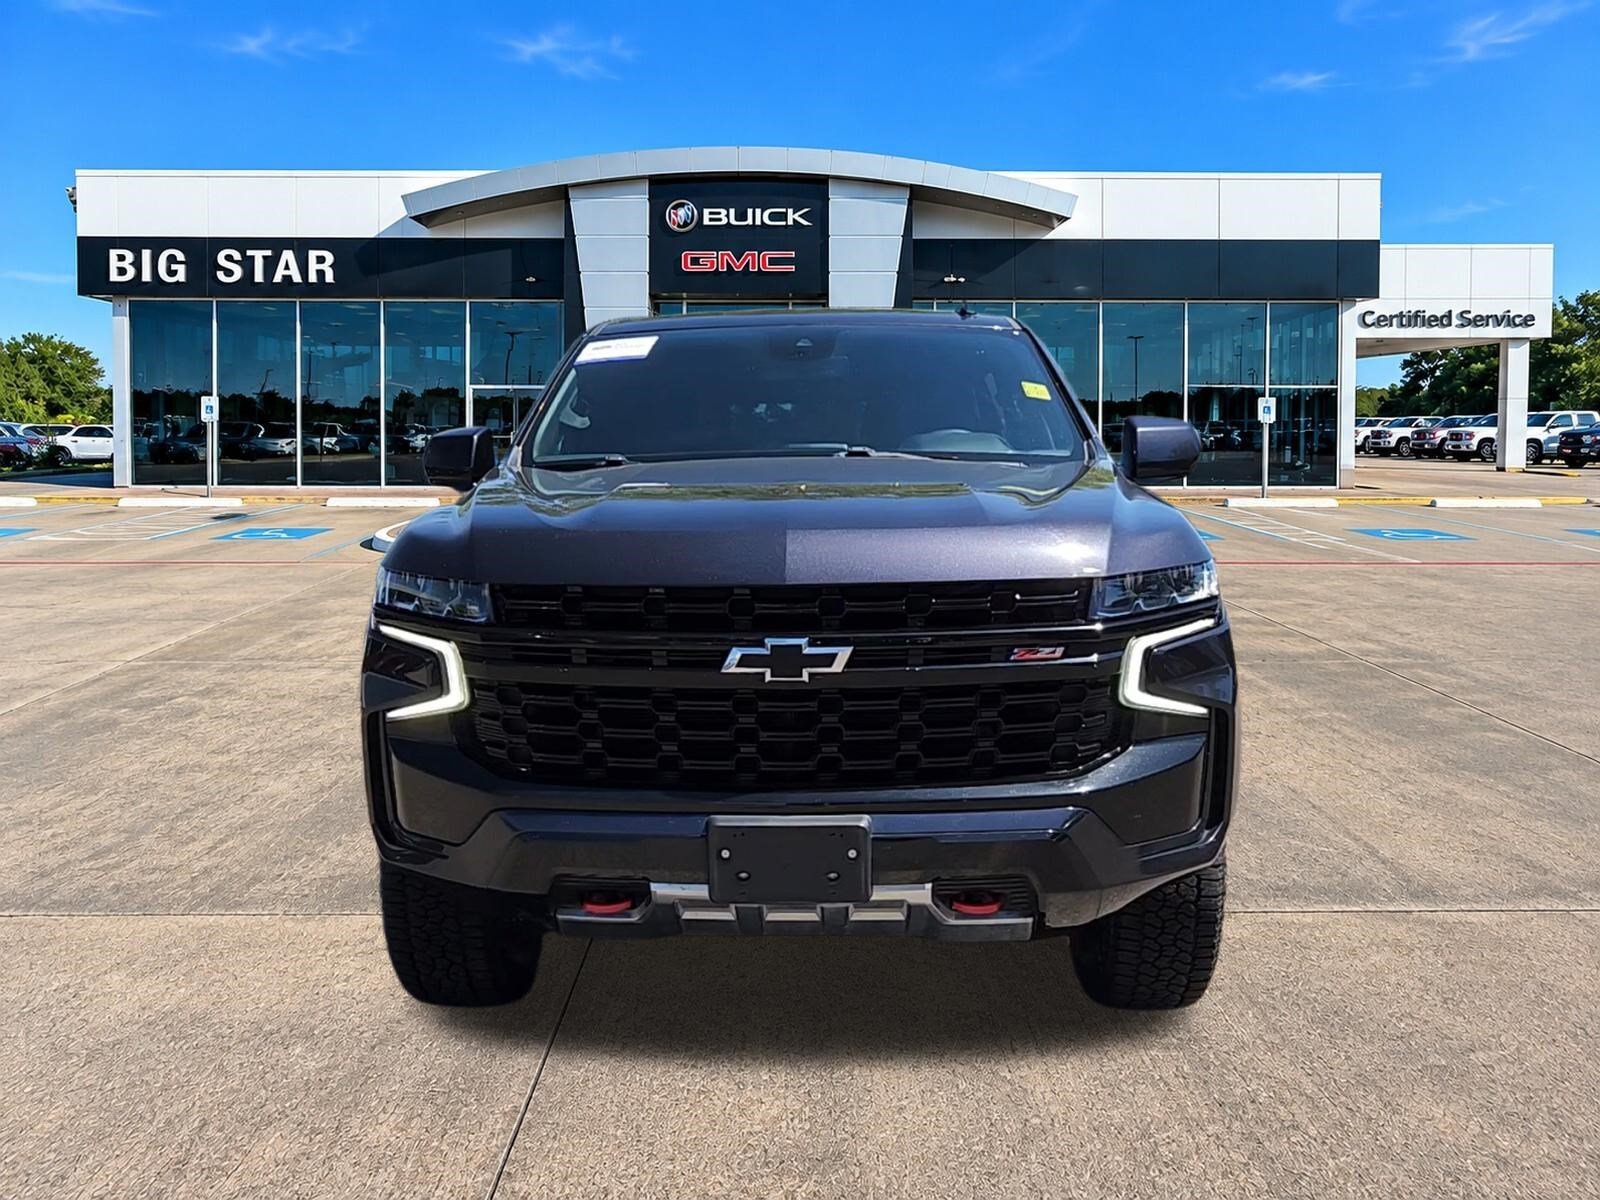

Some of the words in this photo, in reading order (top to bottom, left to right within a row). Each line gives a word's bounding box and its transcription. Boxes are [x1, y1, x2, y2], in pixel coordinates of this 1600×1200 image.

[702, 207, 813, 226] BUICK
[108, 248, 187, 283] BIG
[216, 248, 336, 284] STAR
[681, 251, 796, 272] GMC
[1359, 309, 1452, 328] Certified
[1455, 309, 1536, 328] Service
